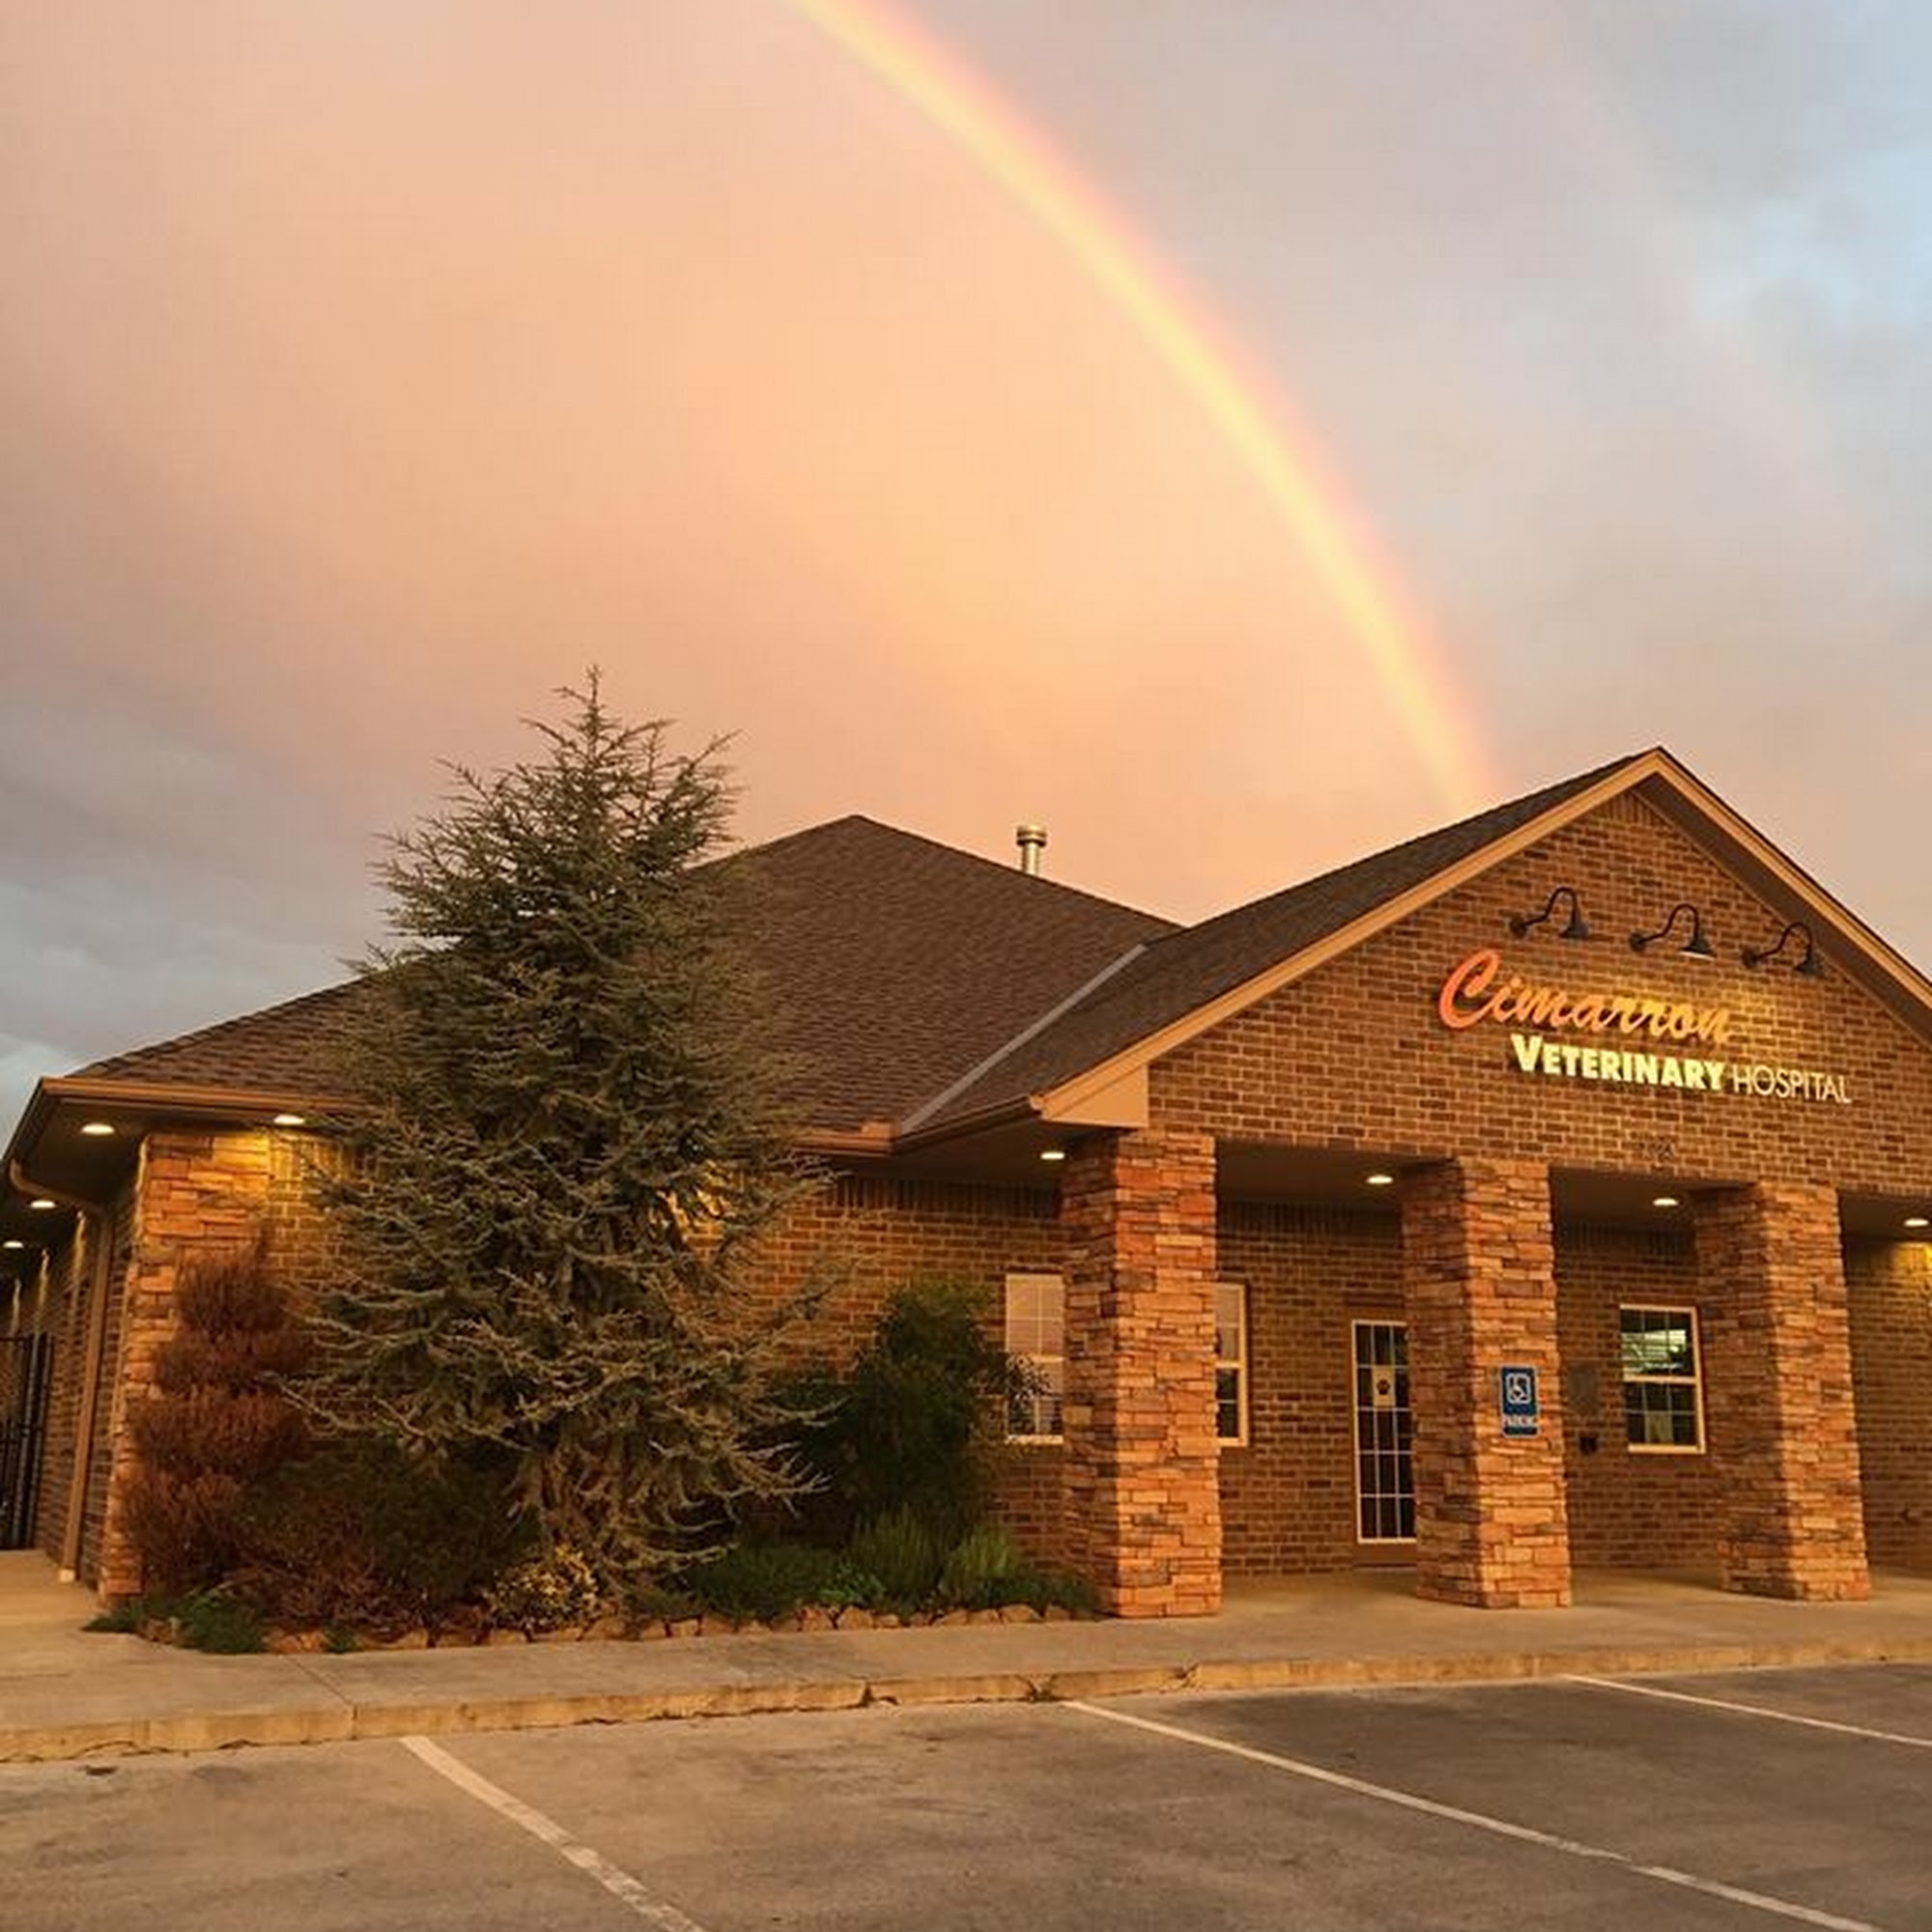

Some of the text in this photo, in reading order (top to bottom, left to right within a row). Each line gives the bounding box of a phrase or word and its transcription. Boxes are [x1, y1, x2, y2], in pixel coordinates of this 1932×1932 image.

[1439, 950, 1732, 1043] Cimarron
[1510, 1034, 1852, 1104] VETERINARY HOSPITAL
